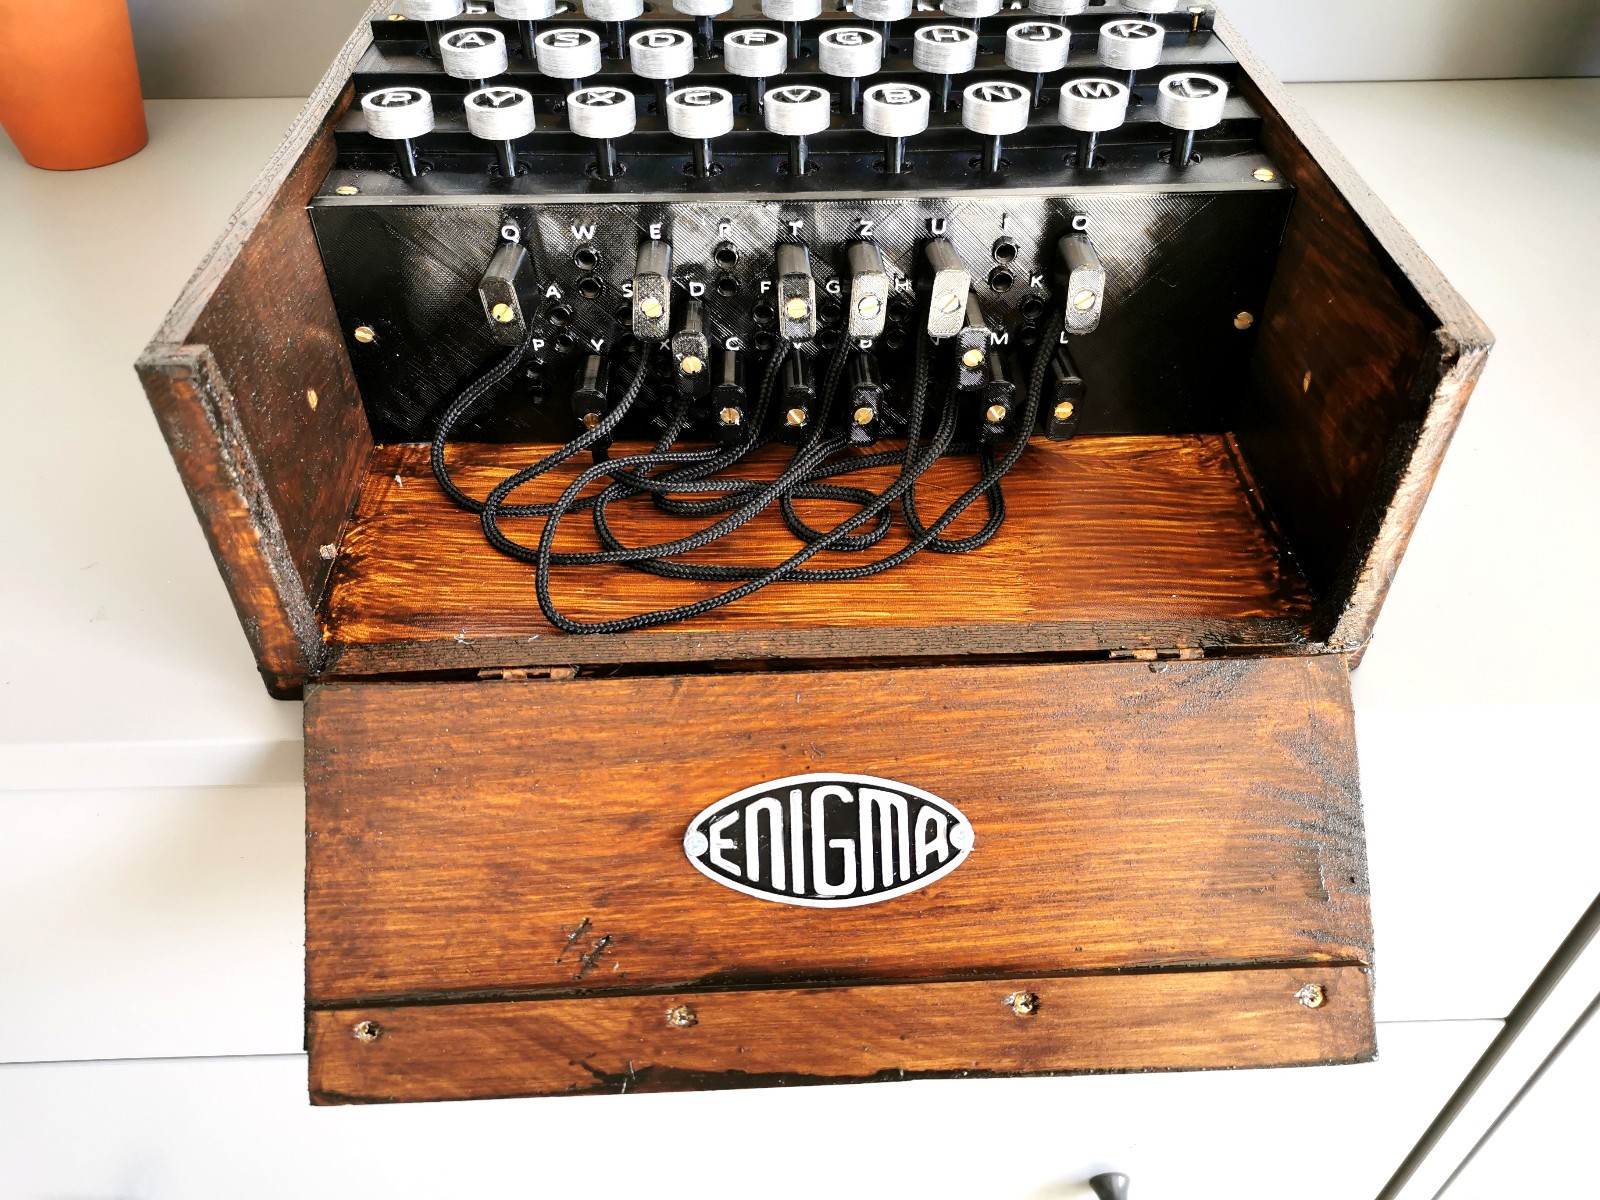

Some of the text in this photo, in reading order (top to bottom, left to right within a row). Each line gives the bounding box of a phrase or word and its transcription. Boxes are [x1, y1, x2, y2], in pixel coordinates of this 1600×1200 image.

[457, 23, 1148, 47] A S D F G H J K
[485, 91, 515, 107] Y
[586, 92, 616, 104] X
[782, 89, 811, 102] V
[984, 86, 1012, 101] N
[1076, 82, 1112, 97] M
[1181, 79, 1210, 97] L
[501, 224, 520, 243] Q
[571, 226, 596, 240] W
[649, 224, 661, 240] E
[718, 223, 732, 239] R
[789, 220, 803, 236] T
[860, 220, 873, 236] Z
[931, 220, 947, 235] U
[546, 285, 561, 299] A
[623, 284, 634, 298] S
[689, 281, 705, 298] D
[760, 281, 772, 294] F
[826, 280, 841, 294] G
[1030, 275, 1044, 288] K
[532, 338, 545, 351] P
[590, 338, 604, 352] Y
[725, 336, 740, 351] C
[990, 332, 1009, 345] M
[1059, 331, 1069, 344] L
[709, 785, 950, 896] ENIGMA
